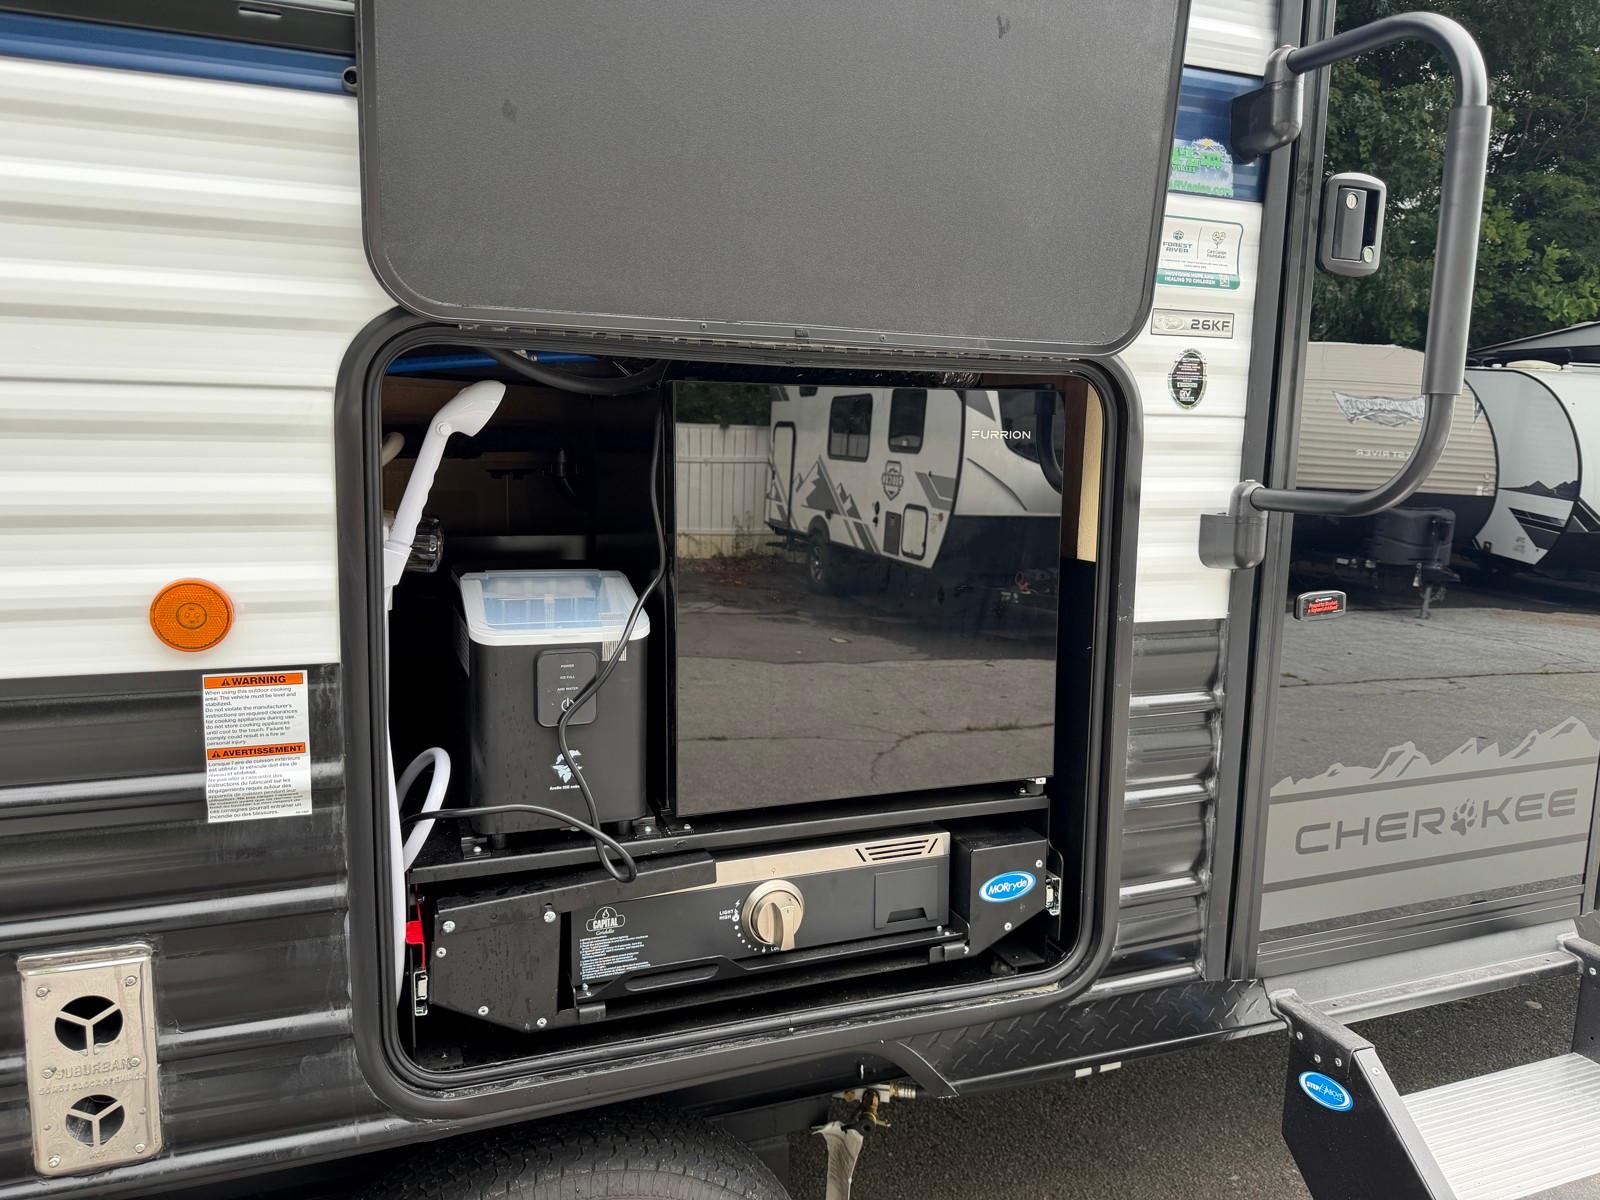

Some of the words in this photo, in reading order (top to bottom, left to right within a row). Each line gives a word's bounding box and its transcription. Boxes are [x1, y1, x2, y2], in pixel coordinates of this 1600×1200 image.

[1162, 241, 1193, 249] FOREST
[1190, 319, 1231, 332] 26KF
[971, 429, 1032, 440] FURRION
[231, 675, 287, 686] WARNING
[222, 745, 303, 757] AVERTISSEMENT
[988, 879, 1028, 895] MORryde
[592, 917, 619, 930] CAPITAL
[54, 1058, 132, 1081] SUBURBAN
[1306, 1080, 1320, 1091] STEP
